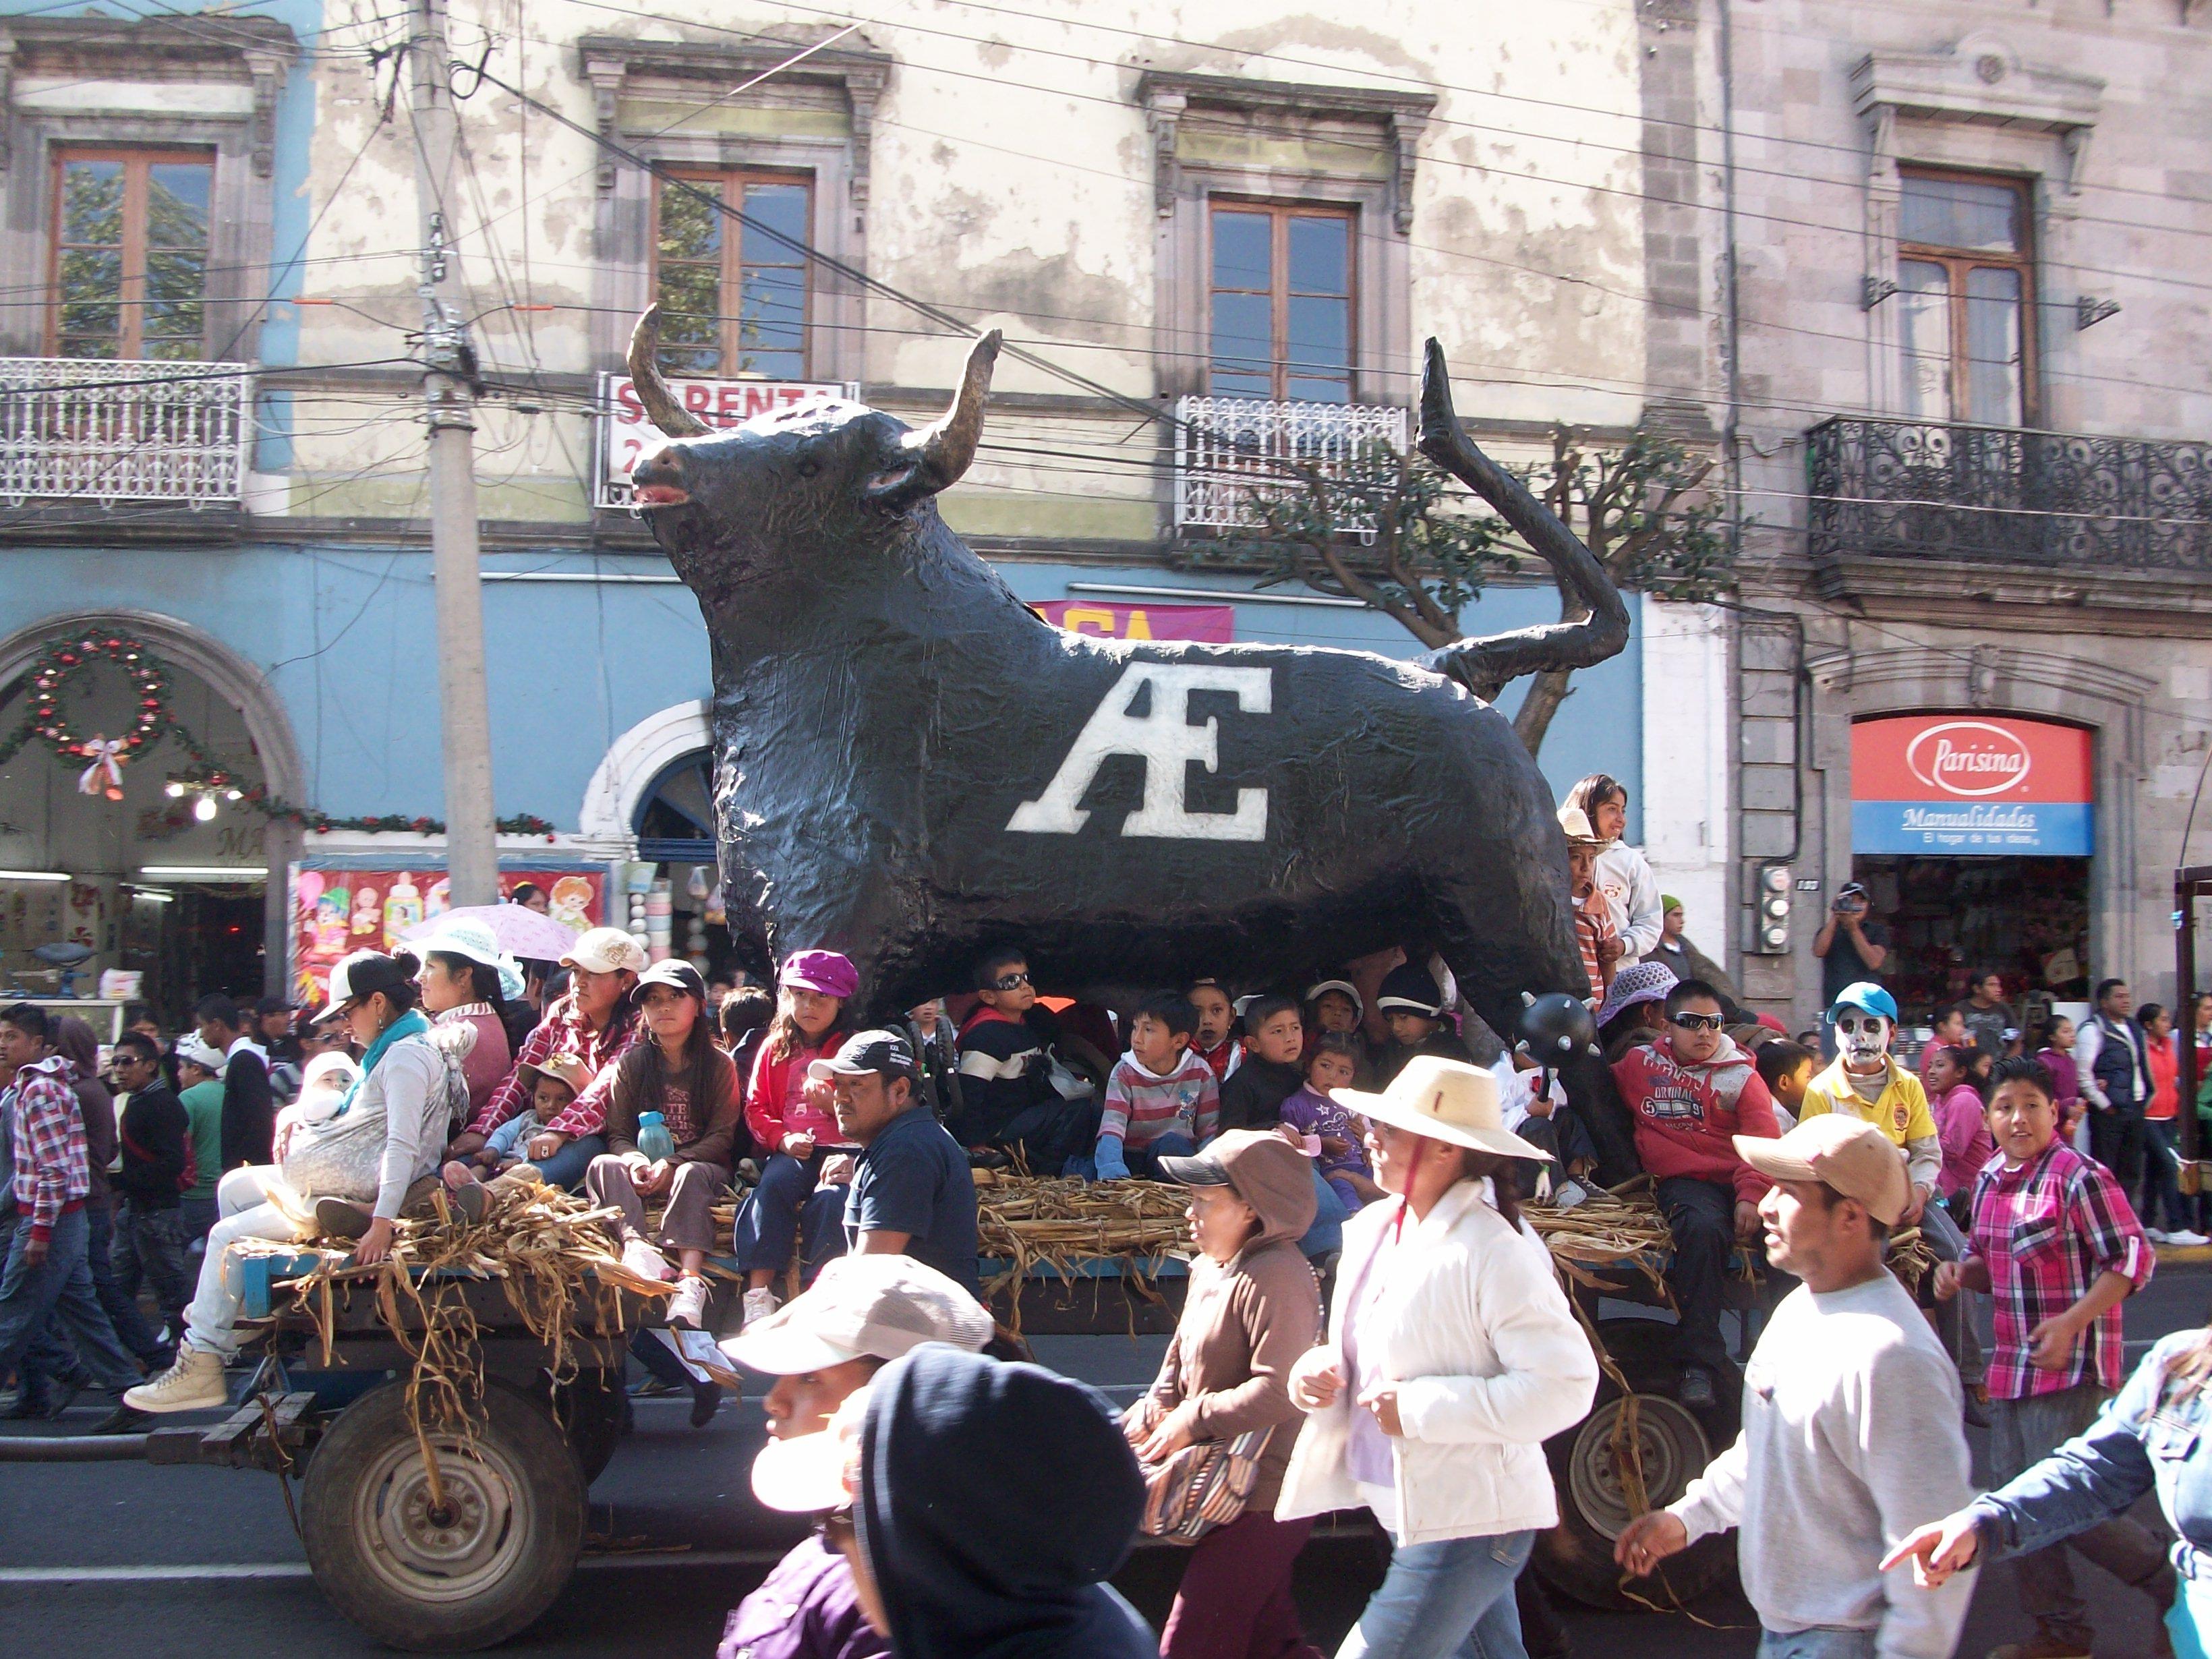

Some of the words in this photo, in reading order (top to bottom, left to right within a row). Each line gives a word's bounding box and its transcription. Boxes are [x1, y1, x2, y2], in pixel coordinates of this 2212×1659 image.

[685, 385, 829, 428] RENT
[1933, 738, 2022, 773] Parisina
[1902, 805, 2036, 828] Manualidades
[1646, 1101, 1656, 1115] 5
